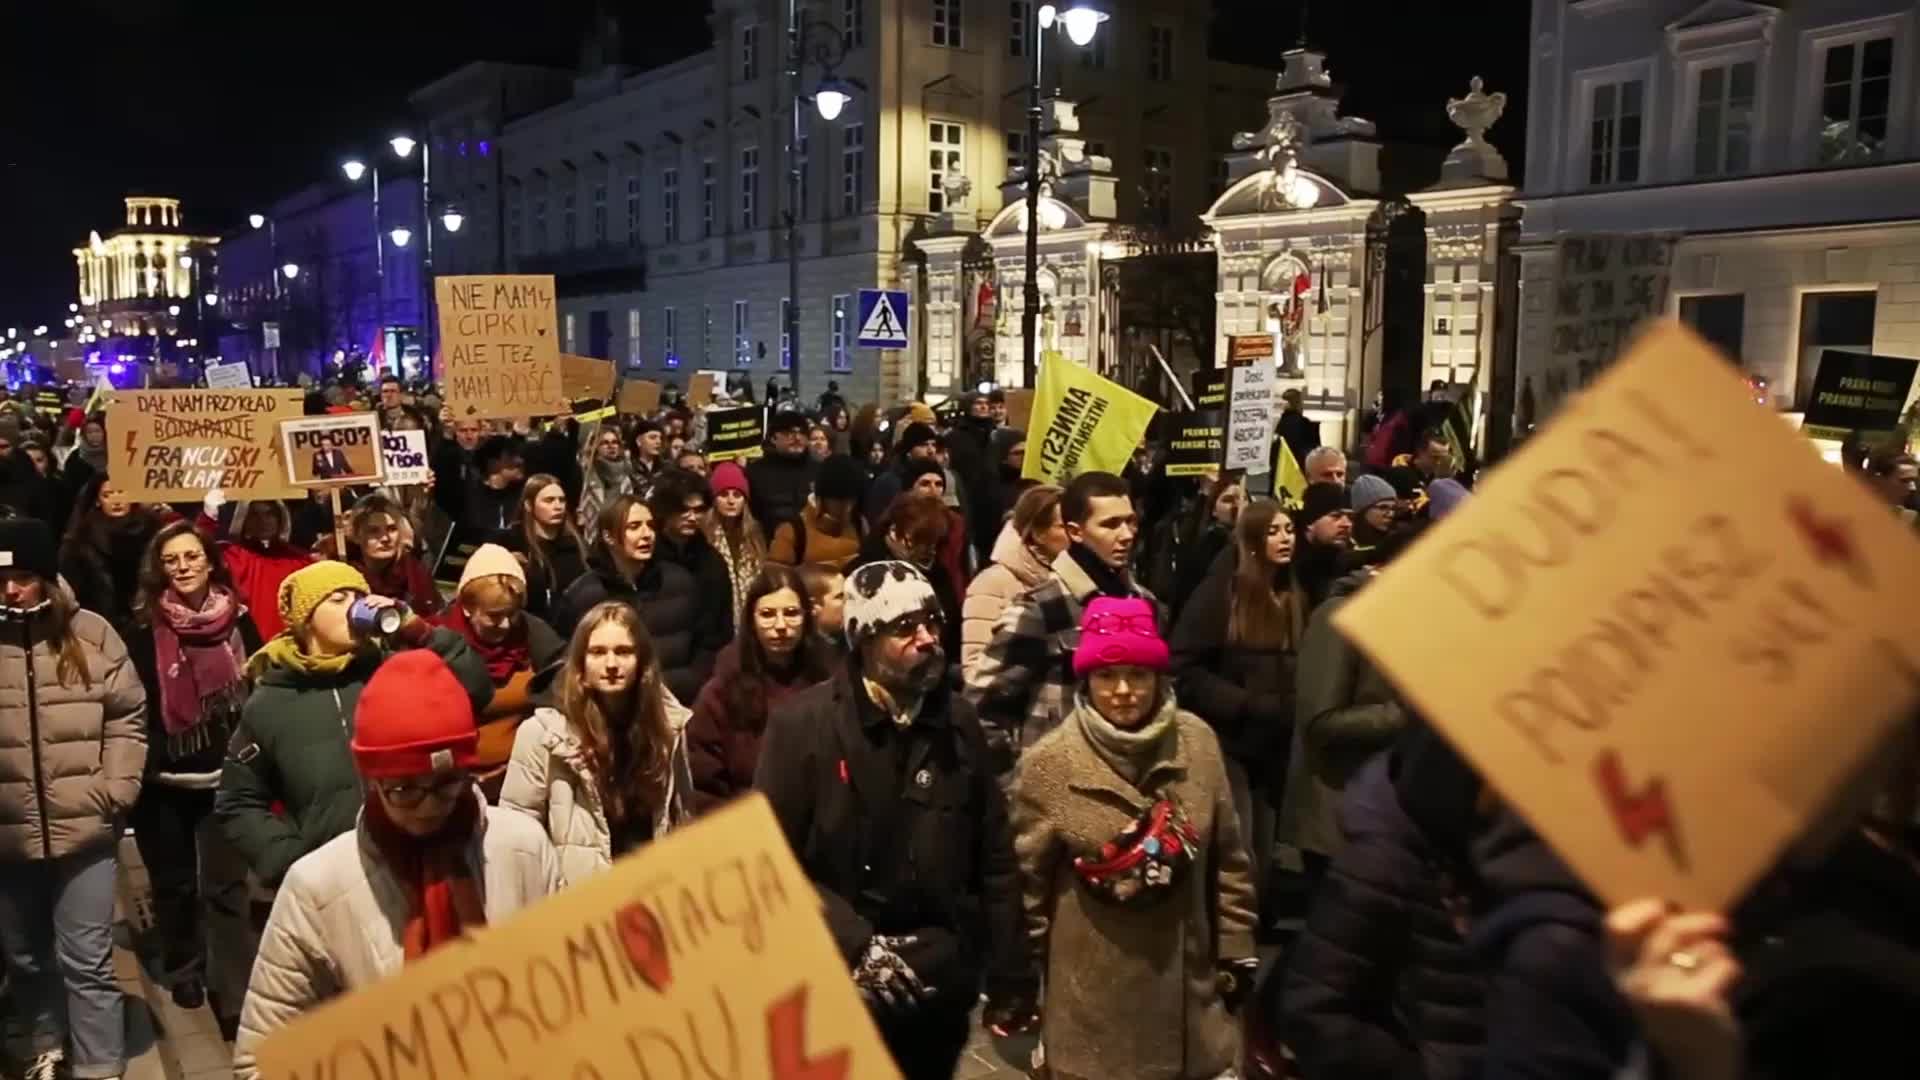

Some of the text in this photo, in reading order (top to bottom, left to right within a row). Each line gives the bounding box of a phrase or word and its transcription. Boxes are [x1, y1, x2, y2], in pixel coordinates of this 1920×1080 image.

[452, 284, 487, 310] NIE
[452, 344, 488, 368] ALE
[453, 376, 491, 400] MAM
[138, 395, 276, 413] DAŁ NAM PRZYKŁAD
[144, 446, 260, 467] FRANCUSKI
[144, 469, 264, 489] PARLAMENT
